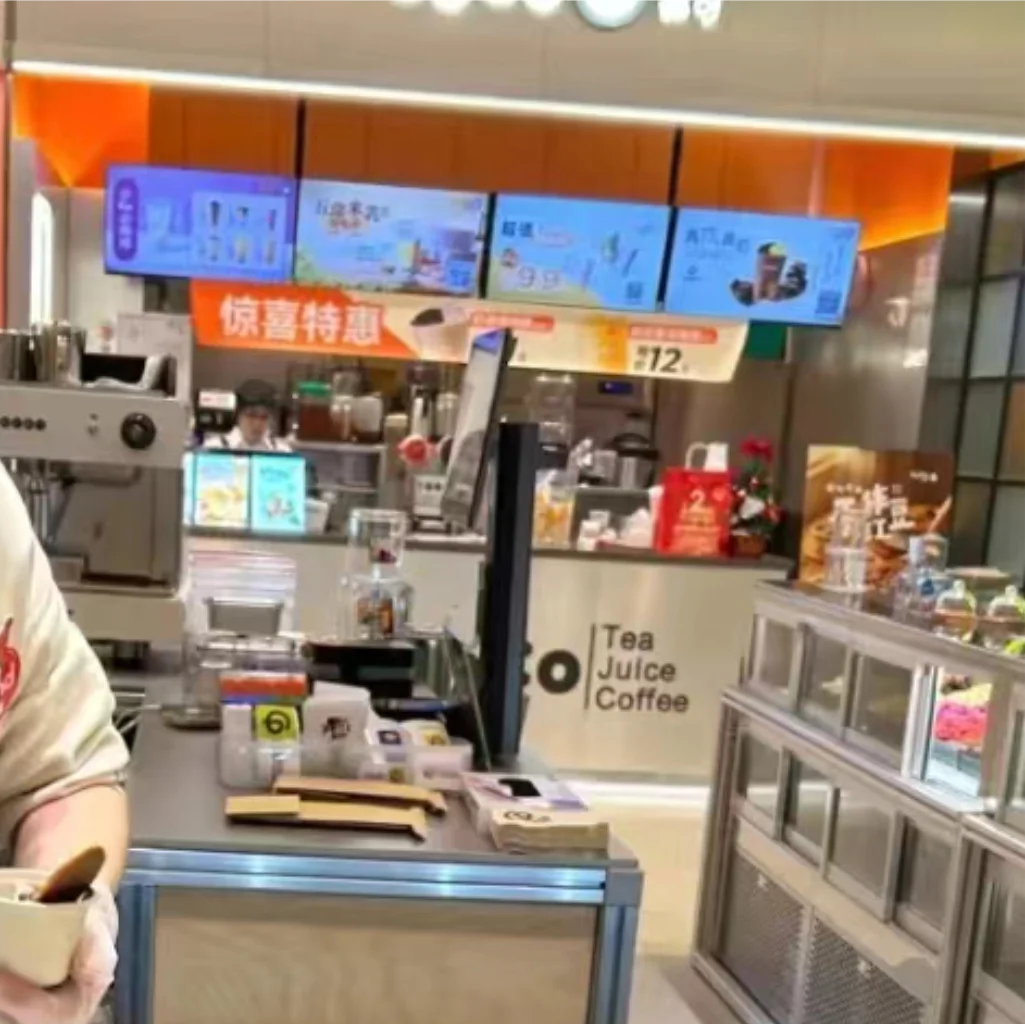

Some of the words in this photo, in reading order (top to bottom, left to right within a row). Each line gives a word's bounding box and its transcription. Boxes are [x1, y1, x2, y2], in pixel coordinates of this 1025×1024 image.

[219, 293, 384, 346] 惊喜特惠
[649, 346, 683, 373] 12
[602, 624, 654, 650] Tea
[598, 656, 676, 682] Juice
[595, 685, 689, 713] Coffee
